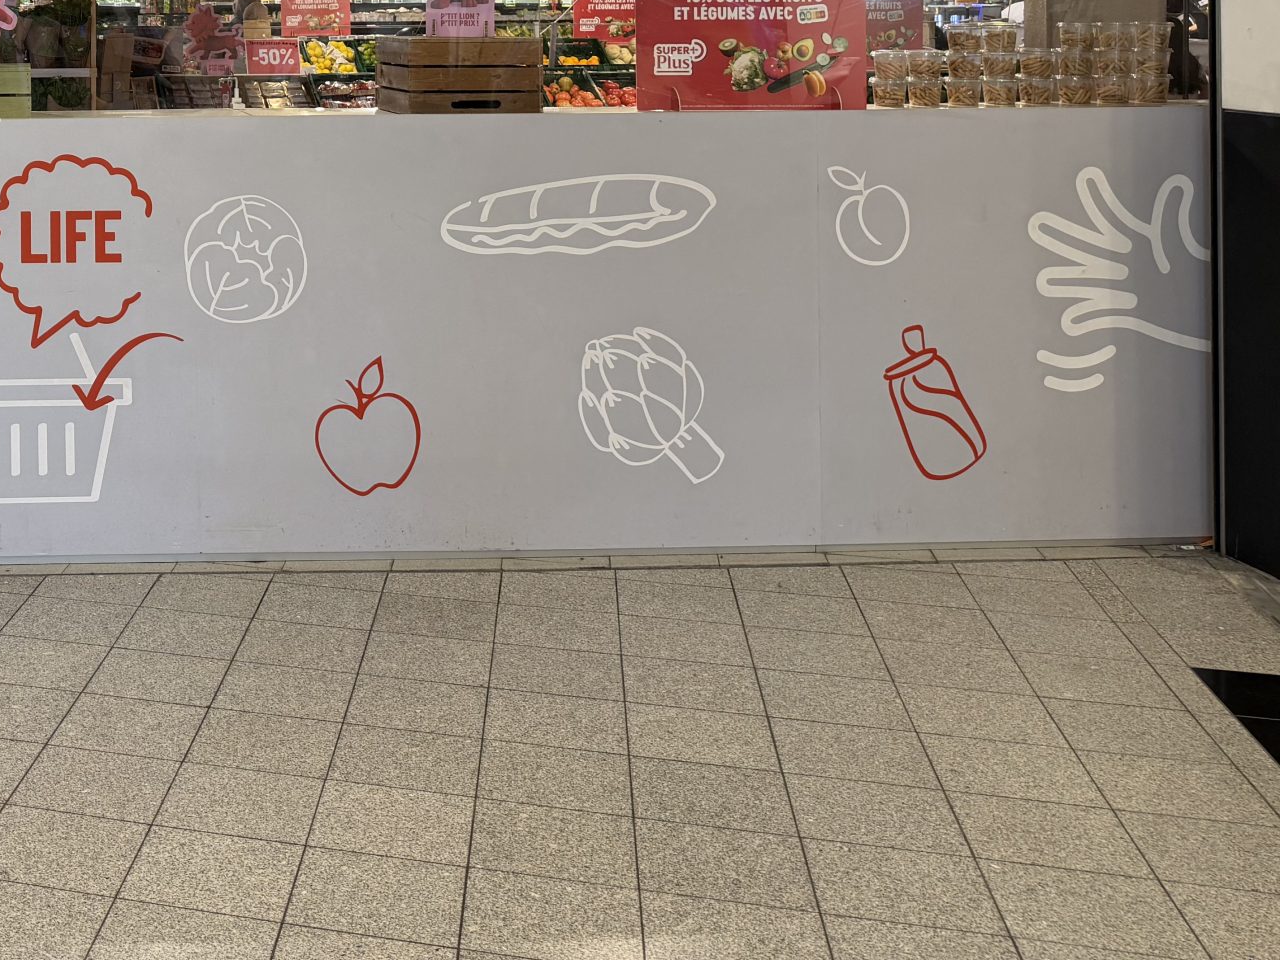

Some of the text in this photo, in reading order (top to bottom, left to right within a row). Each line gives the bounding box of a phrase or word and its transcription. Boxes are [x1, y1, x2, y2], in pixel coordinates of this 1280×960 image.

[674, 3, 793, 21] ET LÉGUMES AVEC
[252, 48, 295, 65] -50%
[656, 54, 690, 69] Plus
[20, 210, 123, 264] LIFE
